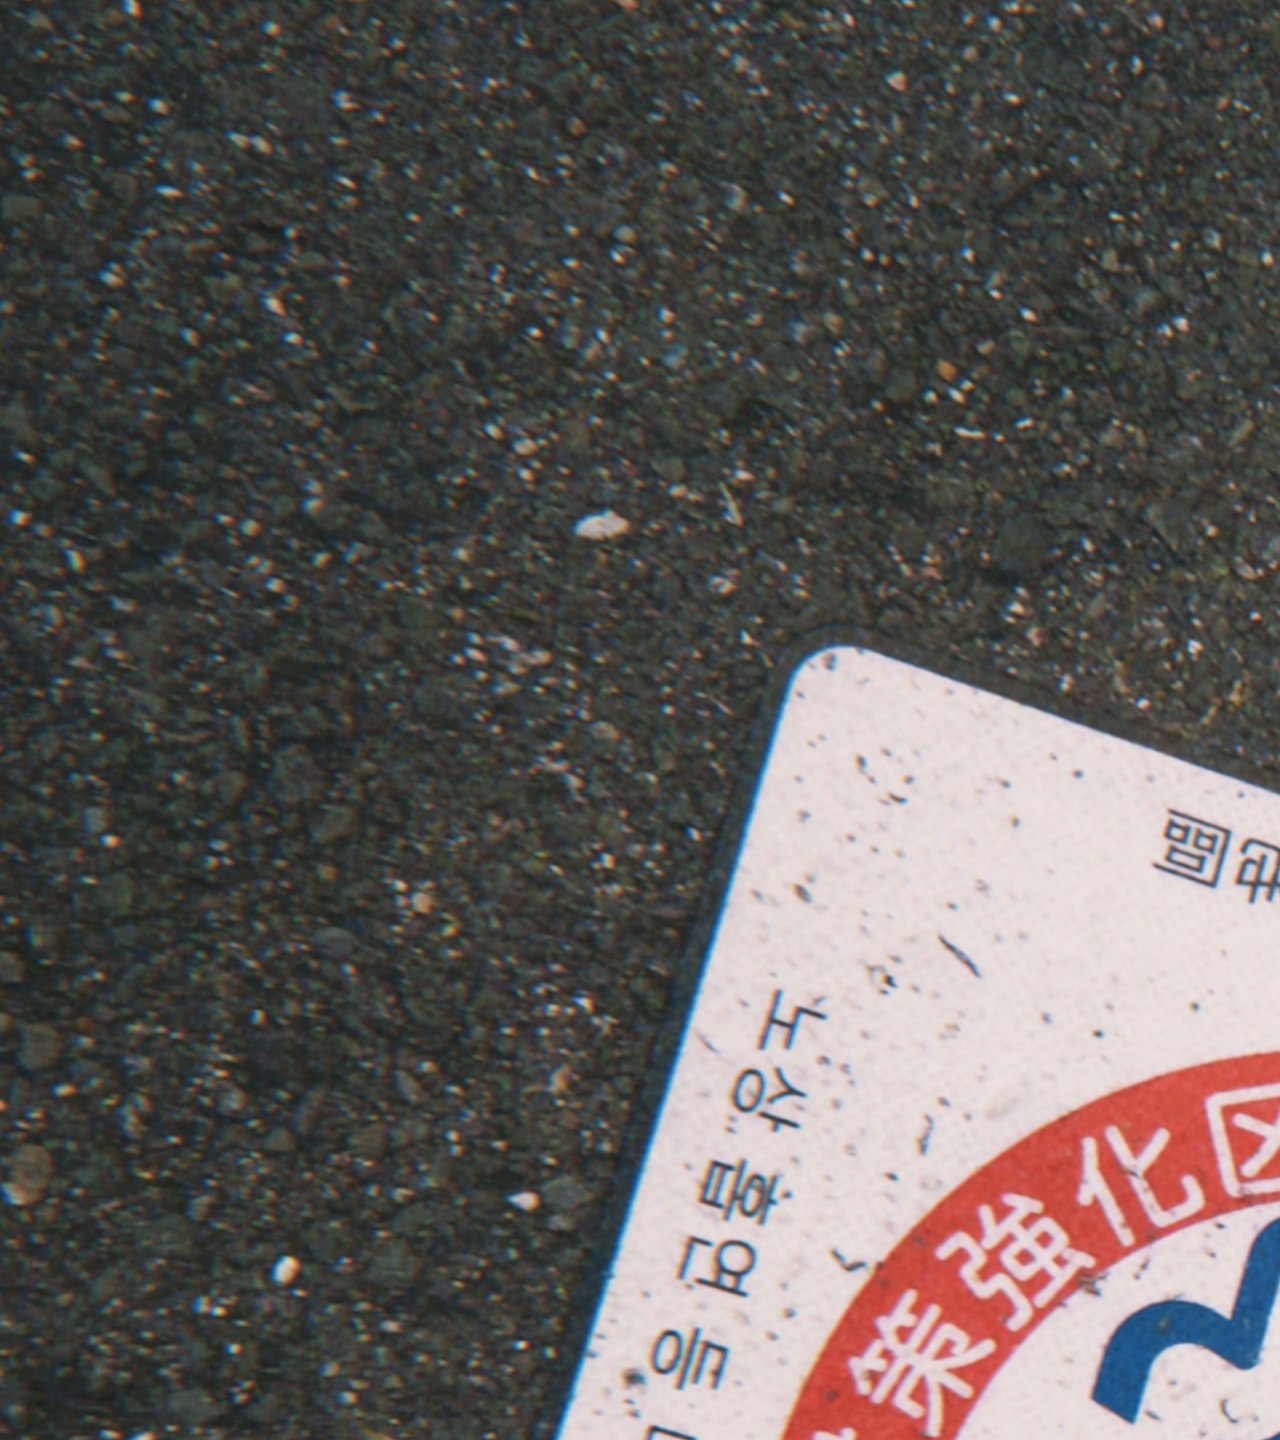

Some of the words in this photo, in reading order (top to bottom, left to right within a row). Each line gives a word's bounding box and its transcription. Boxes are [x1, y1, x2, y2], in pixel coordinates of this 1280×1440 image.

[732, 988, 828, 1131] 노상
[680, 1160, 778, 1296] 흡연
[650, 1327, 730, 1389] 등
